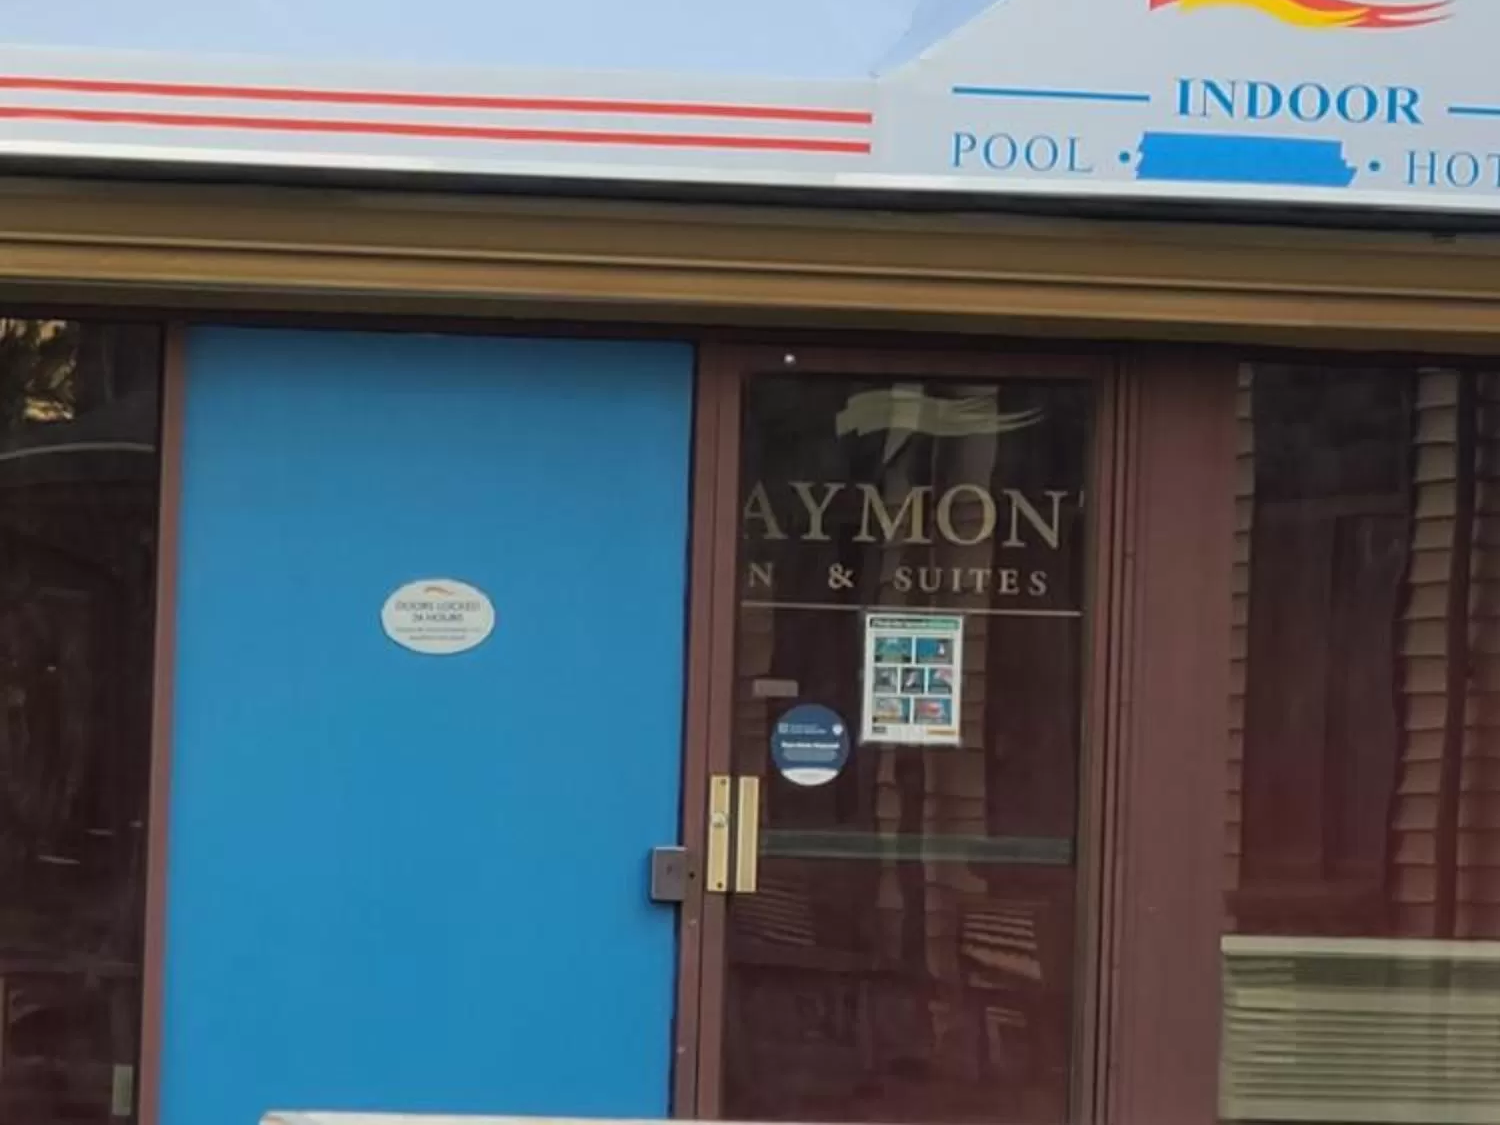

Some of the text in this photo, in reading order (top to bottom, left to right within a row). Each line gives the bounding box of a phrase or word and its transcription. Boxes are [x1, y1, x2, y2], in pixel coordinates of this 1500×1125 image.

[1175, 78, 1424, 125] INDOOR
[953, 131, 1093, 173] POOL
[743, 480, 1084, 549] AYMON
[828, 562, 854, 589] &
[894, 566, 1048, 596] SUITES
